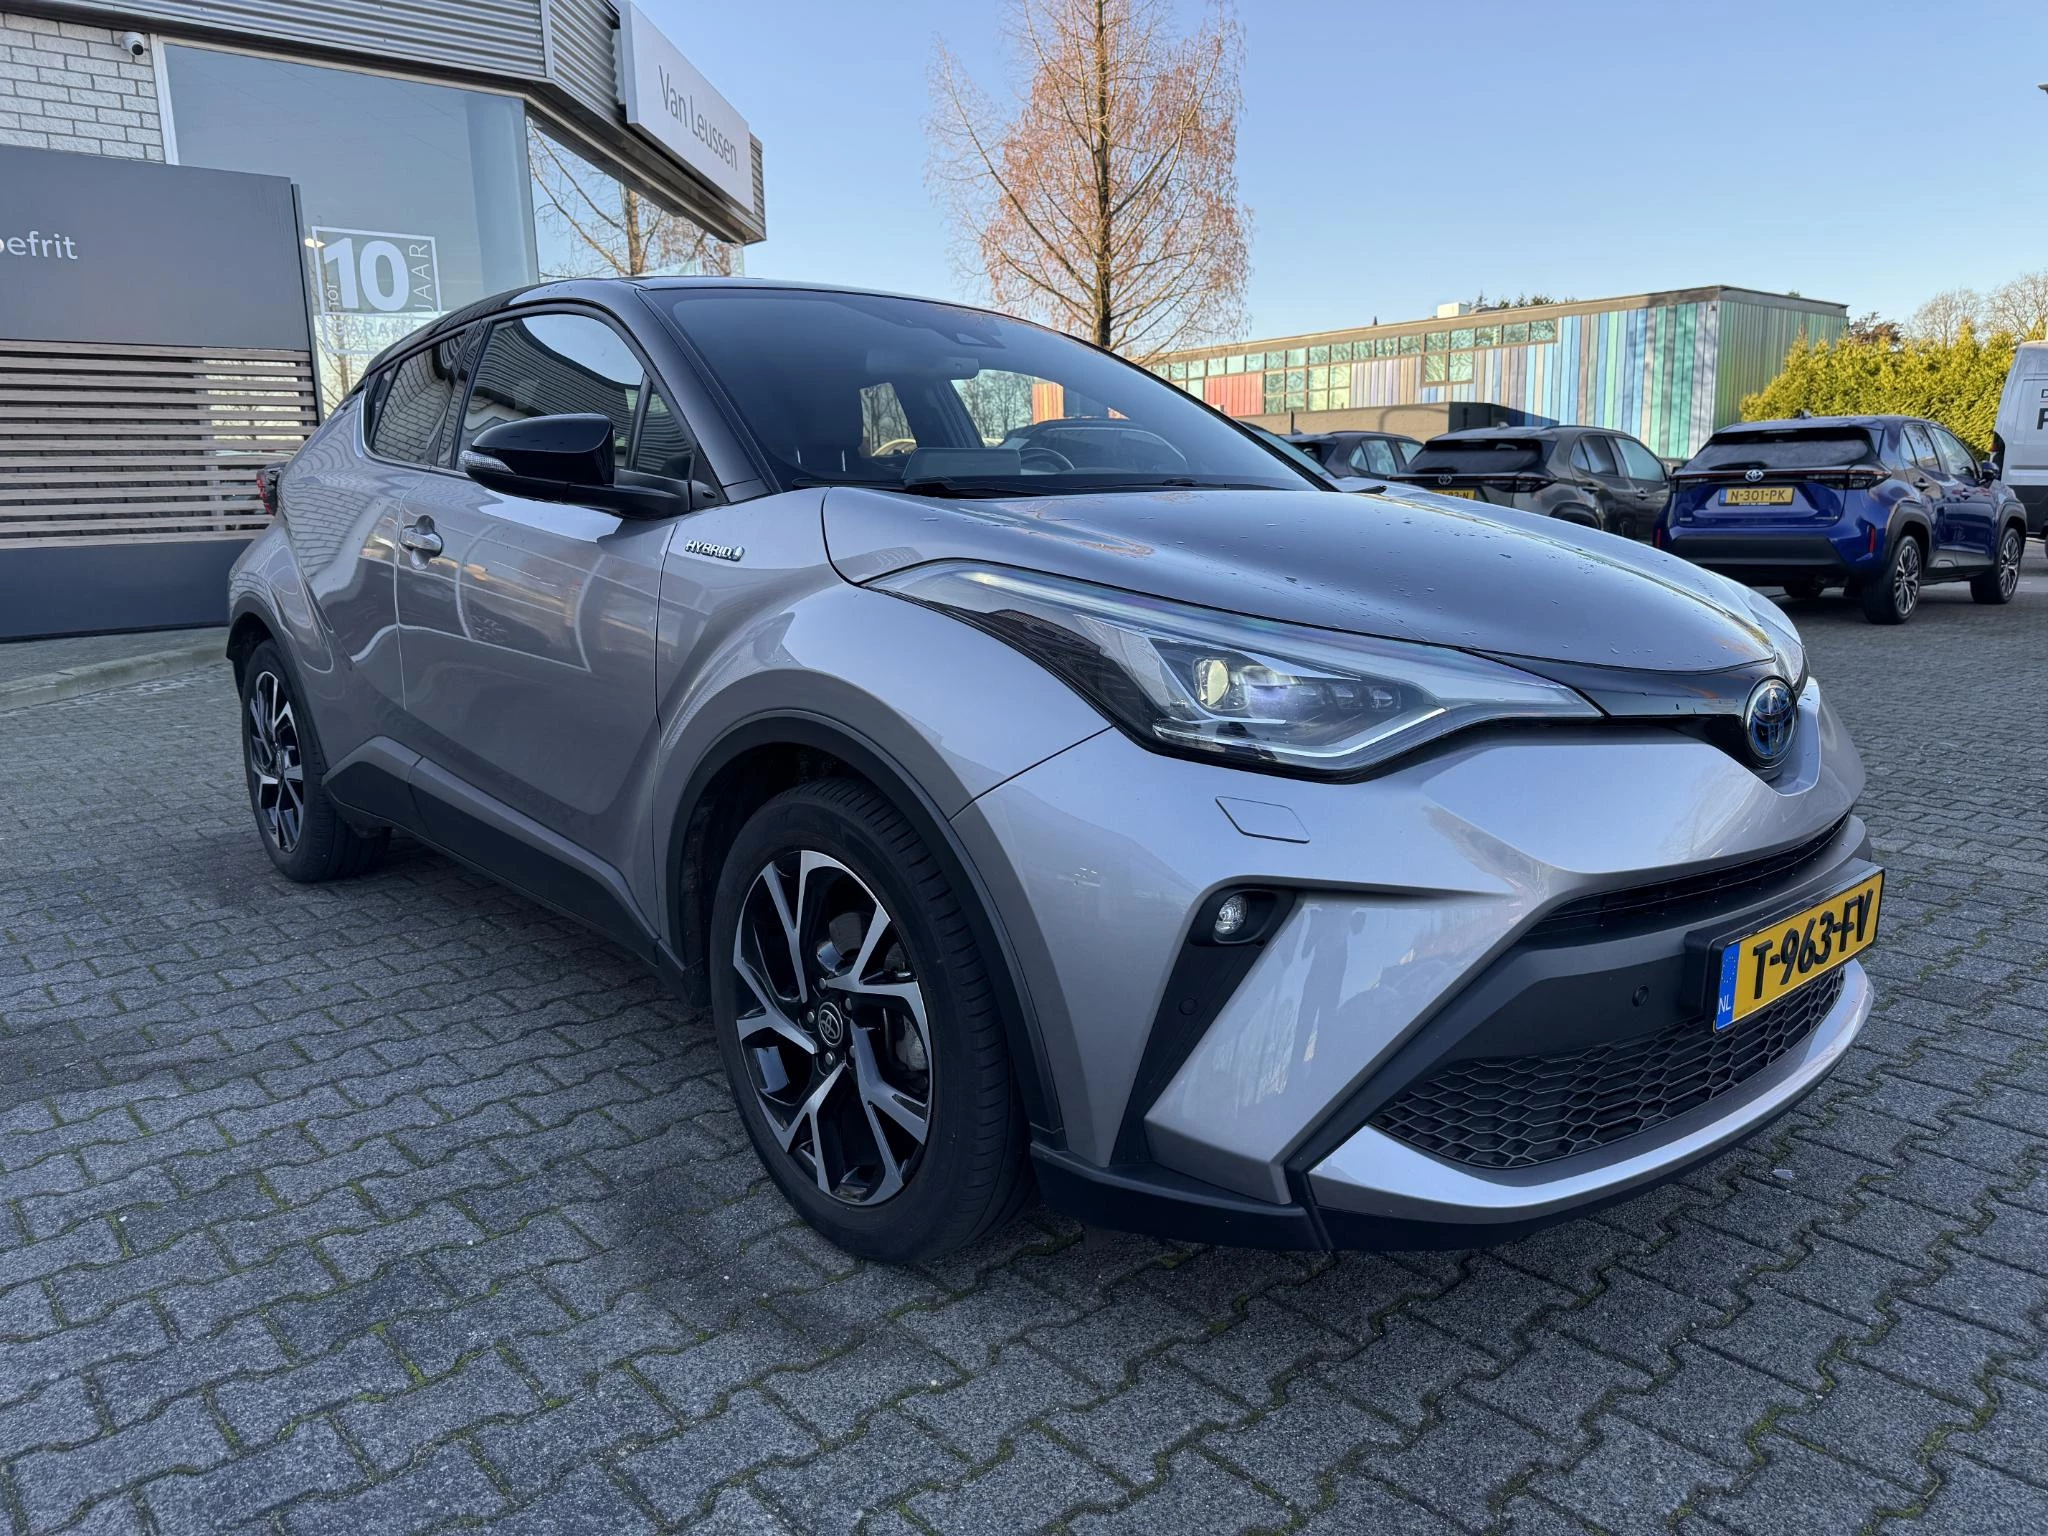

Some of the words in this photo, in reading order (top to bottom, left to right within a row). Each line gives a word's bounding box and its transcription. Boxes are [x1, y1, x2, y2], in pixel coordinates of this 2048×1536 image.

[658, 64, 688, 129] Van
[689, 94, 738, 172] Leussen
[0, 230, 79, 260] efrit
[323, 237, 410, 312] 10
[408, 243, 435, 314] JAAR
[1730, 489, 1786, 502] N-301-PK
[684, 539, 733, 560] HYBRID
[1717, 994, 1732, 1015] NL
[1752, 888, 1874, 1000] T-963-FV
